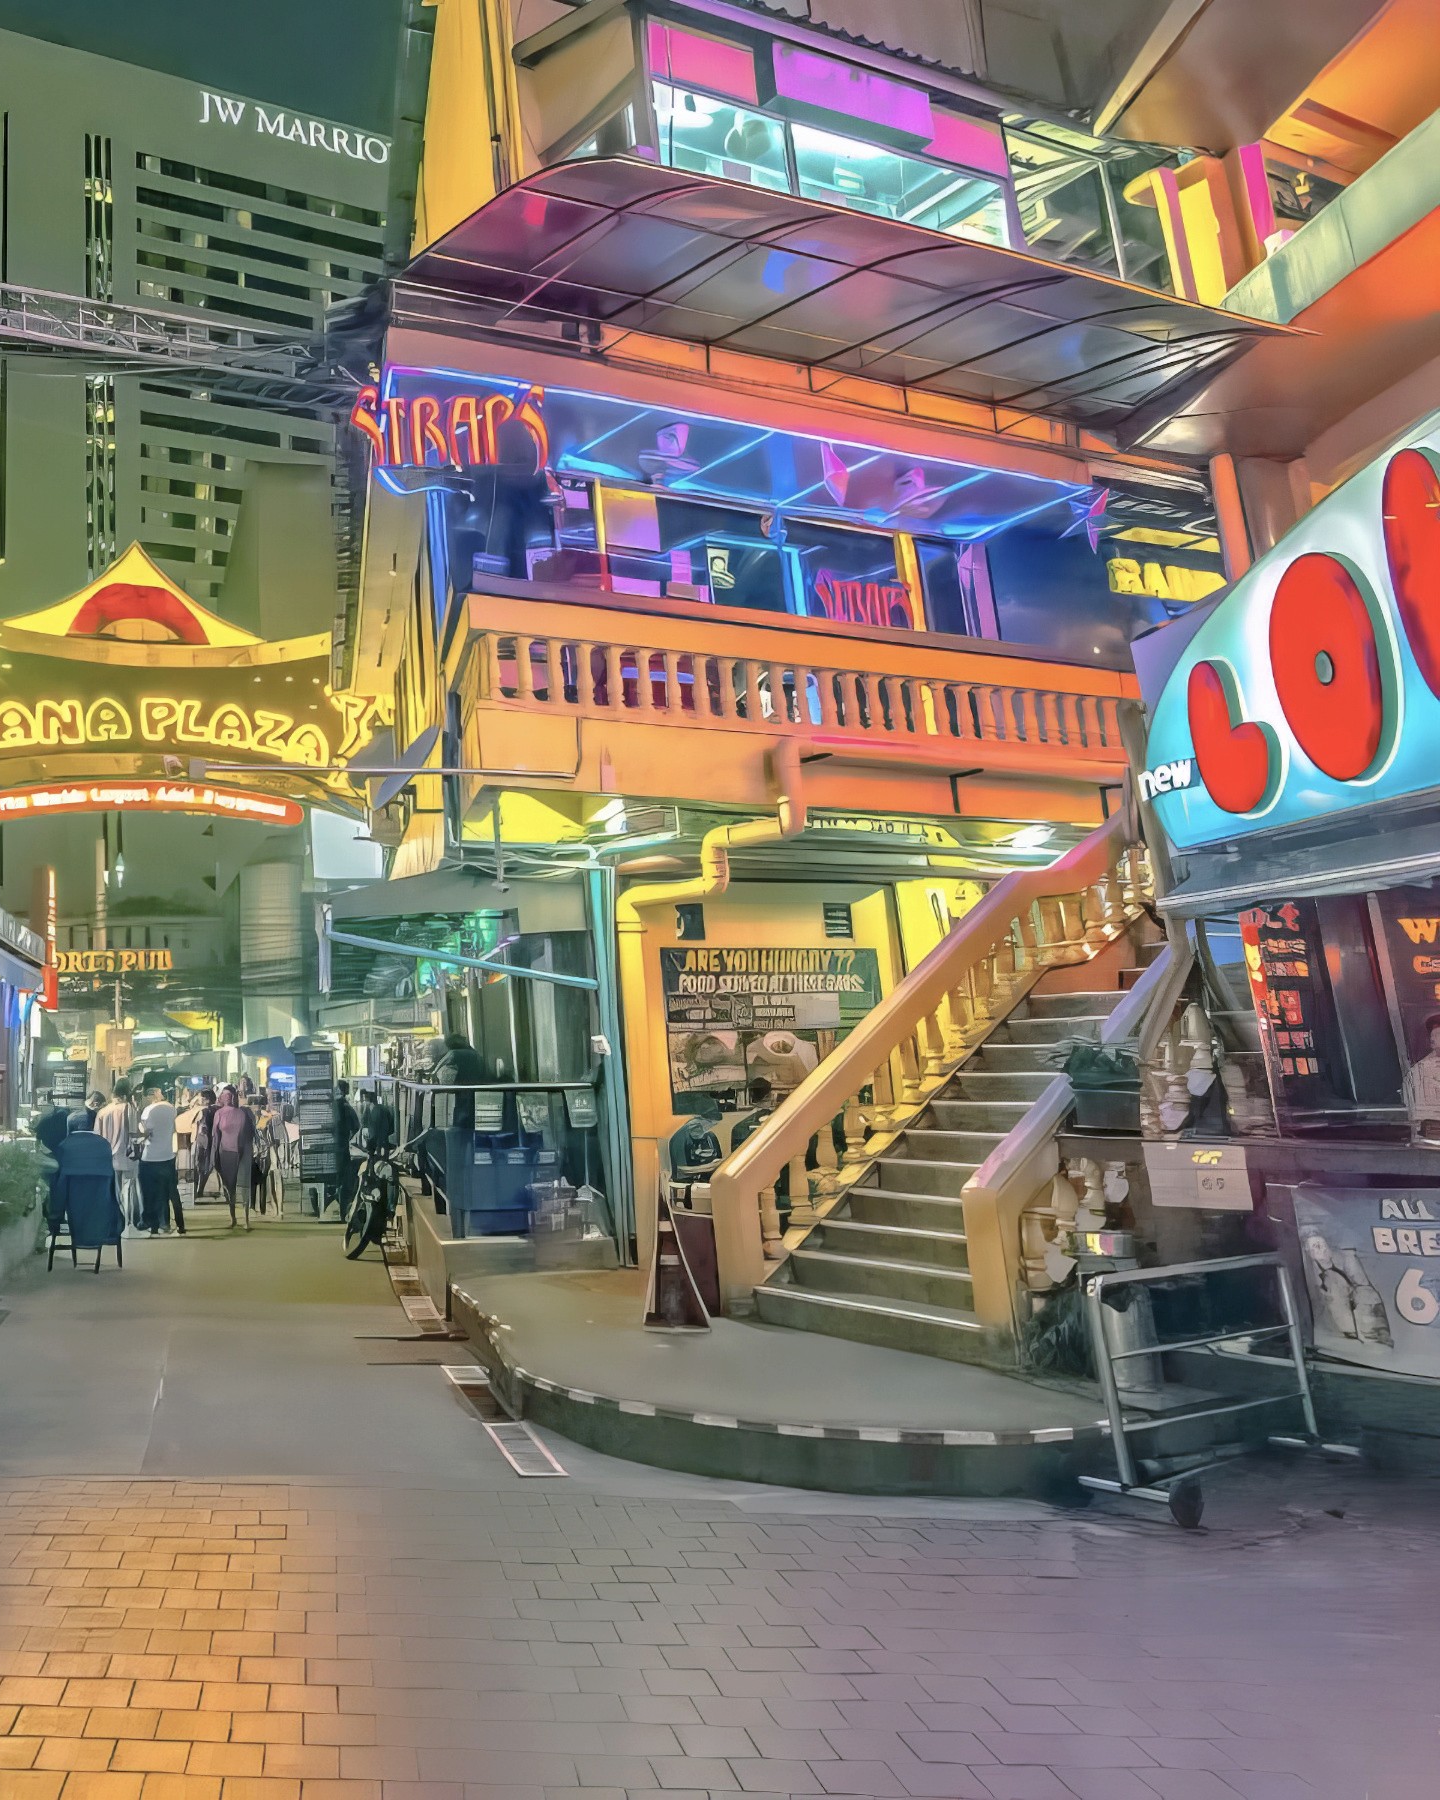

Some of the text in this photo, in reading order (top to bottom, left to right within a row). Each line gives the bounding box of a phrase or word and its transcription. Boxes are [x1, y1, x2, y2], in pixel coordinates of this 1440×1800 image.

[199, 91, 391, 163] JW MARRIO
[350, 385, 549, 475] STRAPS
[140, 697, 329, 768] PLAZA
[1138, 758, 1191, 802] new
[684, 950, 721, 972] ARE
[721, 950, 759, 972] YOU
[1380, 1199, 1435, 1220] ALL
